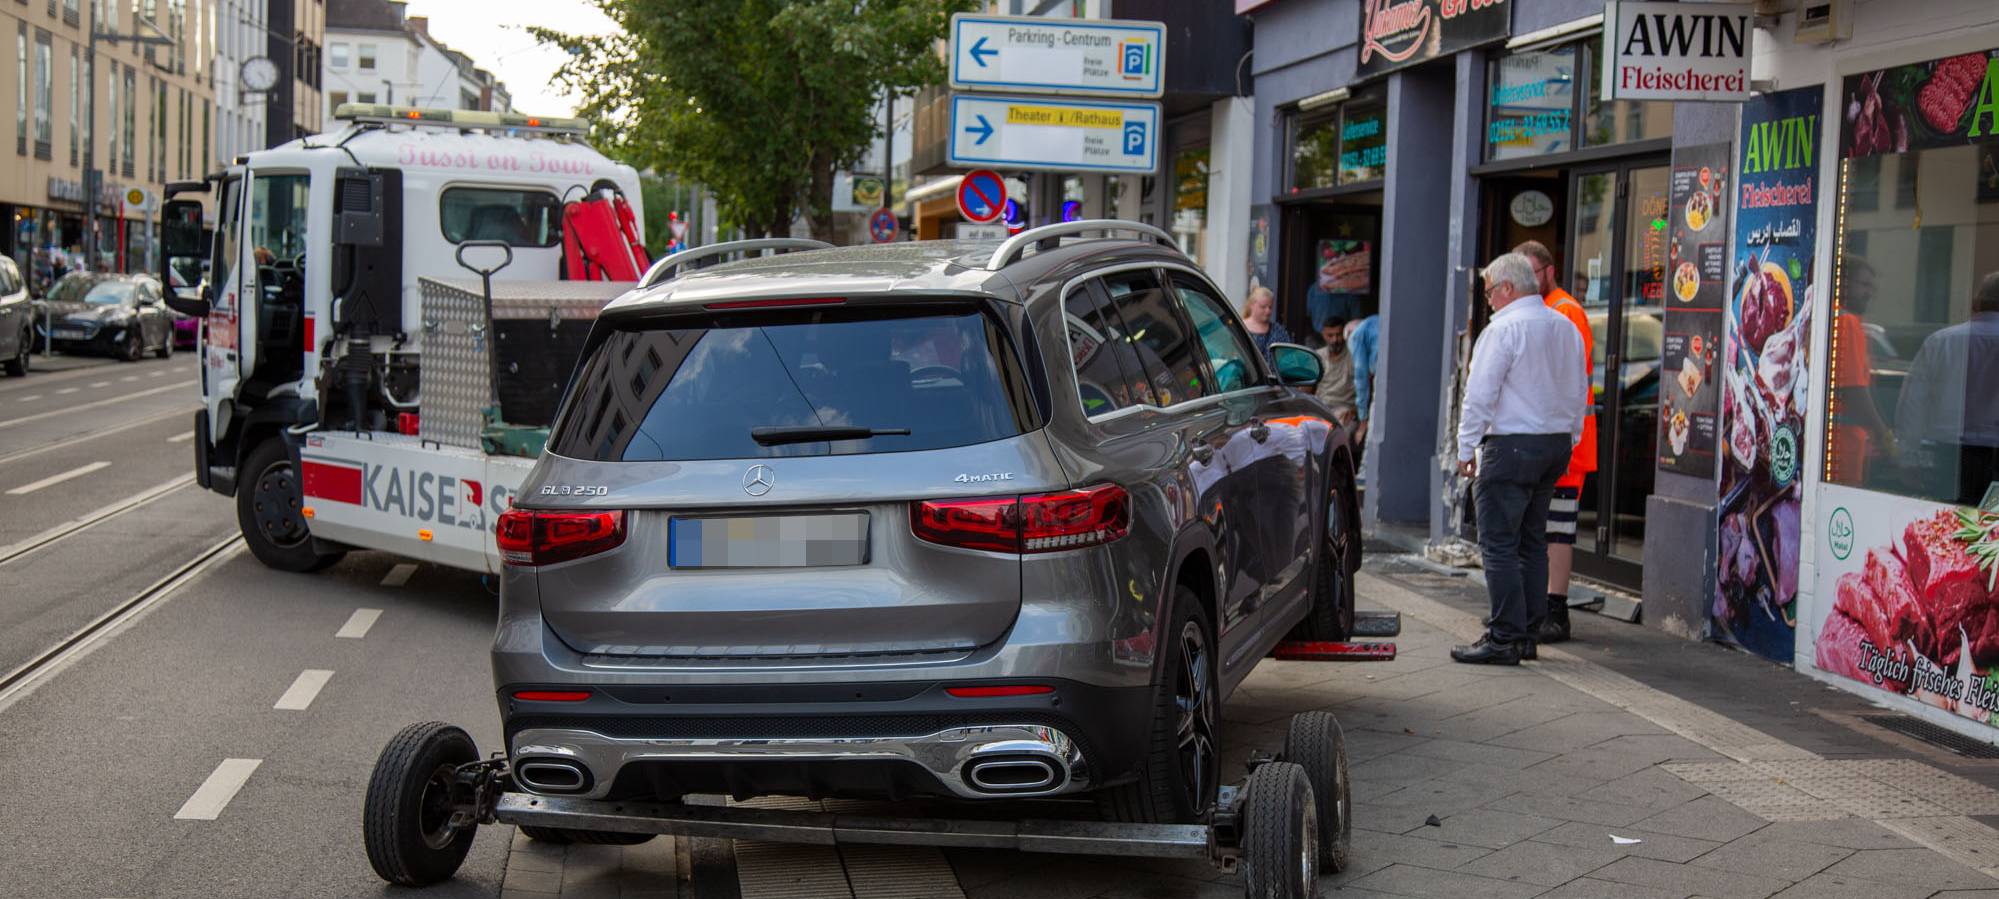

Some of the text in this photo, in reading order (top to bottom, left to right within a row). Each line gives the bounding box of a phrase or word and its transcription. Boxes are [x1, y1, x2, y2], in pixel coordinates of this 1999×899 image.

[1008, 27, 1055, 48] Parkring
[1063, 30, 1112, 47] Centrum
[1622, 13, 1748, 57] AWIN
[1622, 66, 1745, 92] Fleischerei
[1009, 107, 1051, 121] Theater
[1744, 115, 1815, 174] AWIN
[398, 144, 595, 176] Tussi on Tour
[1742, 177, 1812, 209] Fleischerei
[574, 485, 608, 497] 250
[954, 472, 1015, 483] 4MATIC
[1859, 640, 1908, 683] Täglich
[1907, 656, 1963, 700] frisches
